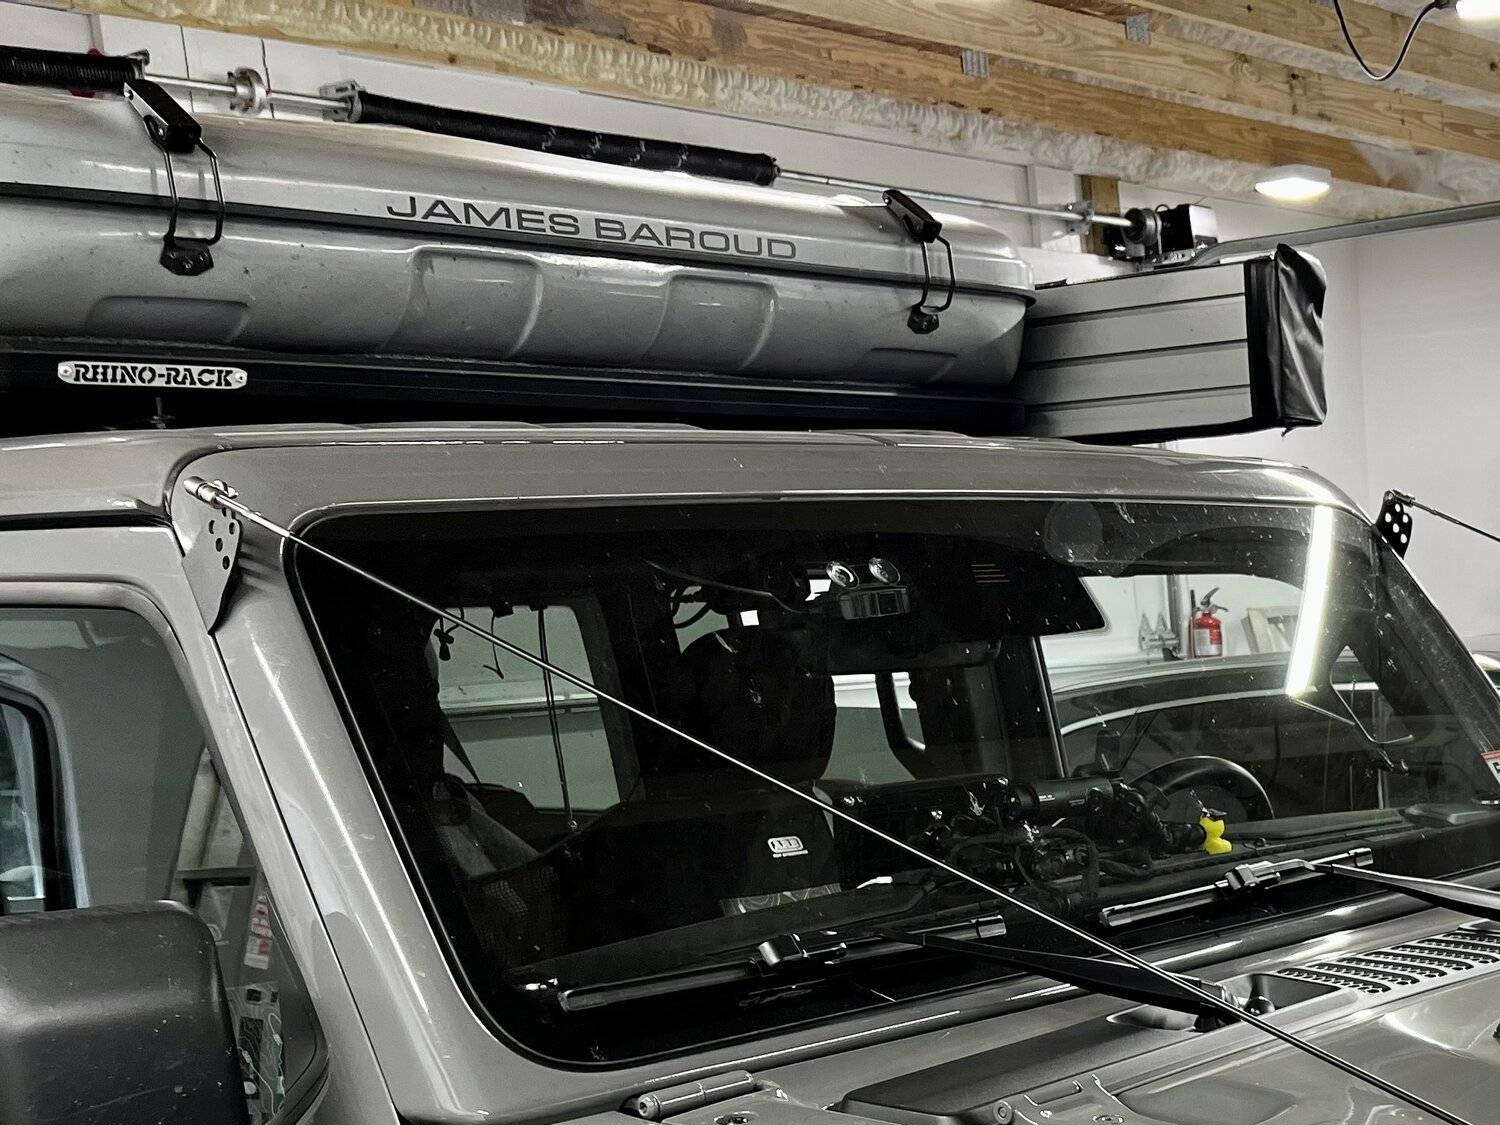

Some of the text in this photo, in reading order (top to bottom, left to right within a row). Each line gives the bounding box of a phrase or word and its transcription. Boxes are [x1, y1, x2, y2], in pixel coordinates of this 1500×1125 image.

[386, 196, 796, 259] JAMES BAROUD
[73, 363, 233, 387] RHINO-RACK
